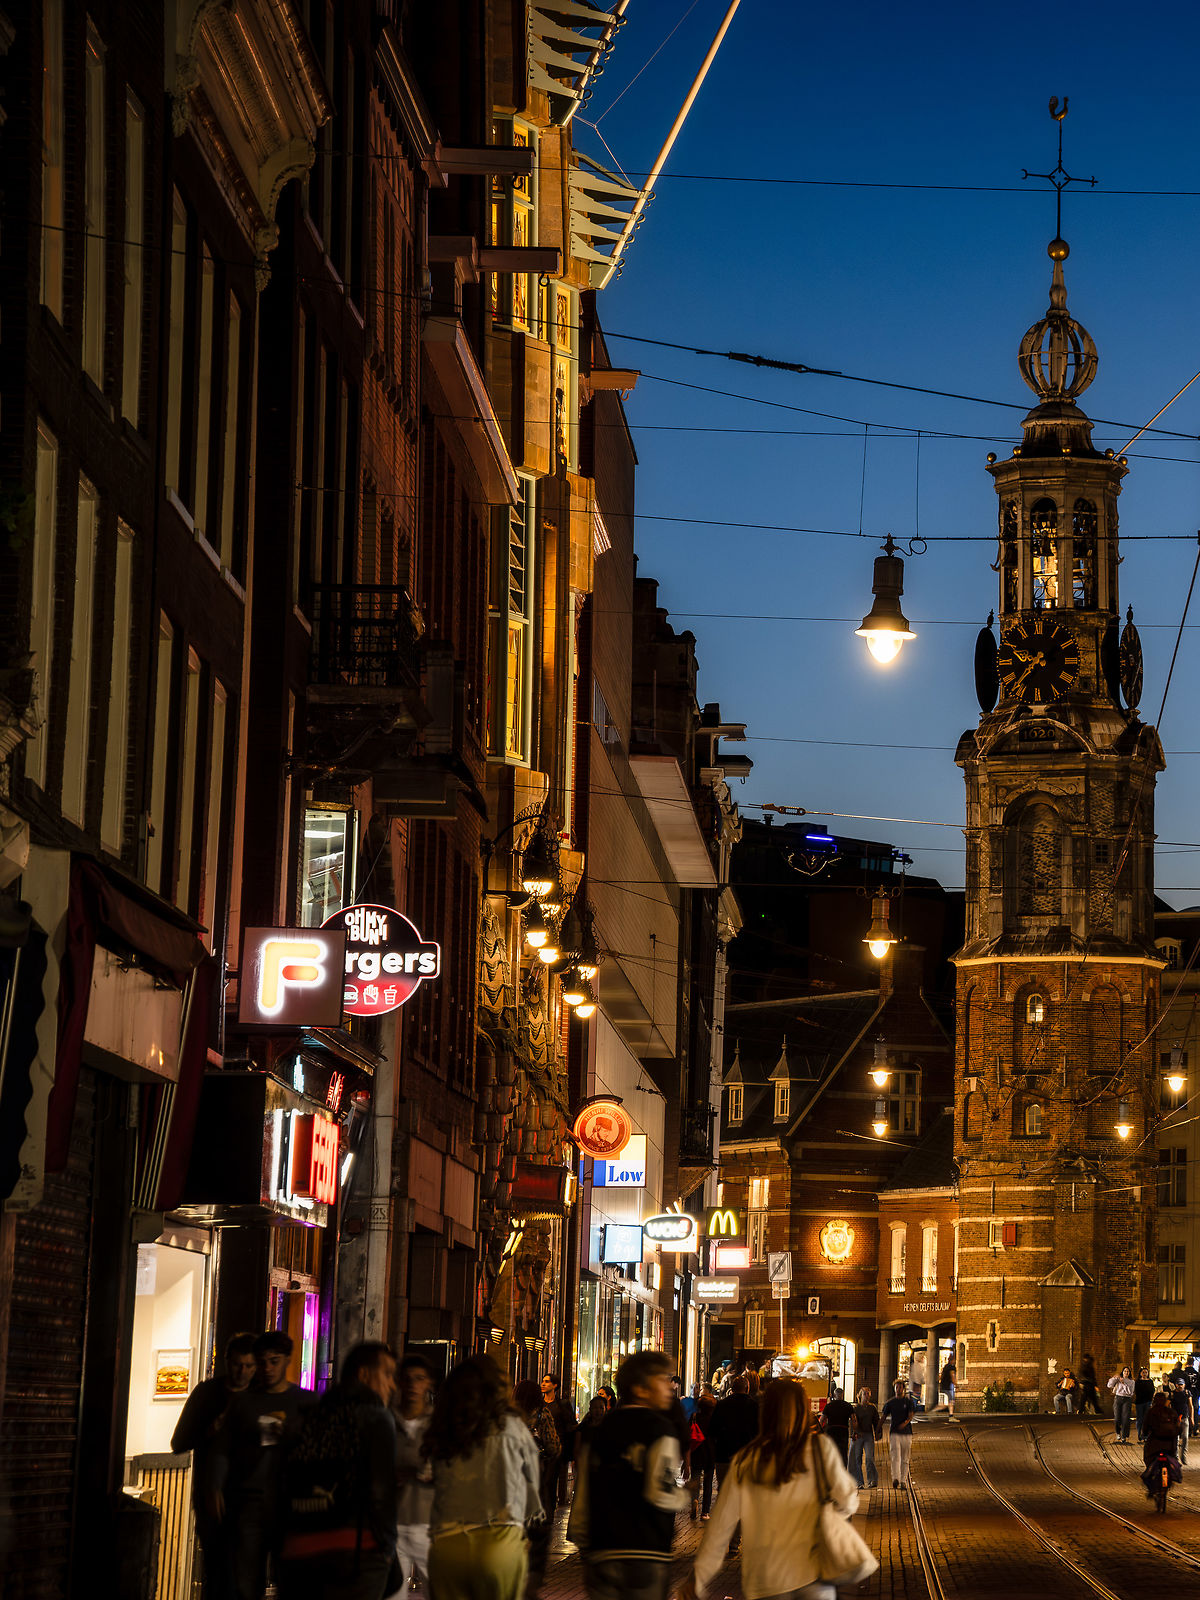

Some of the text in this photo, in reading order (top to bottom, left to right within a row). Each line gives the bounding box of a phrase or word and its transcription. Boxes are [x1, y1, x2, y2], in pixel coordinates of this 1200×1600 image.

[345, 952, 437, 981] rgers
[608, 1165, 643, 1182] Low
[919, 1302, 934, 1311] DELFTS
[935, 1301, 951, 1311] BLAUW
